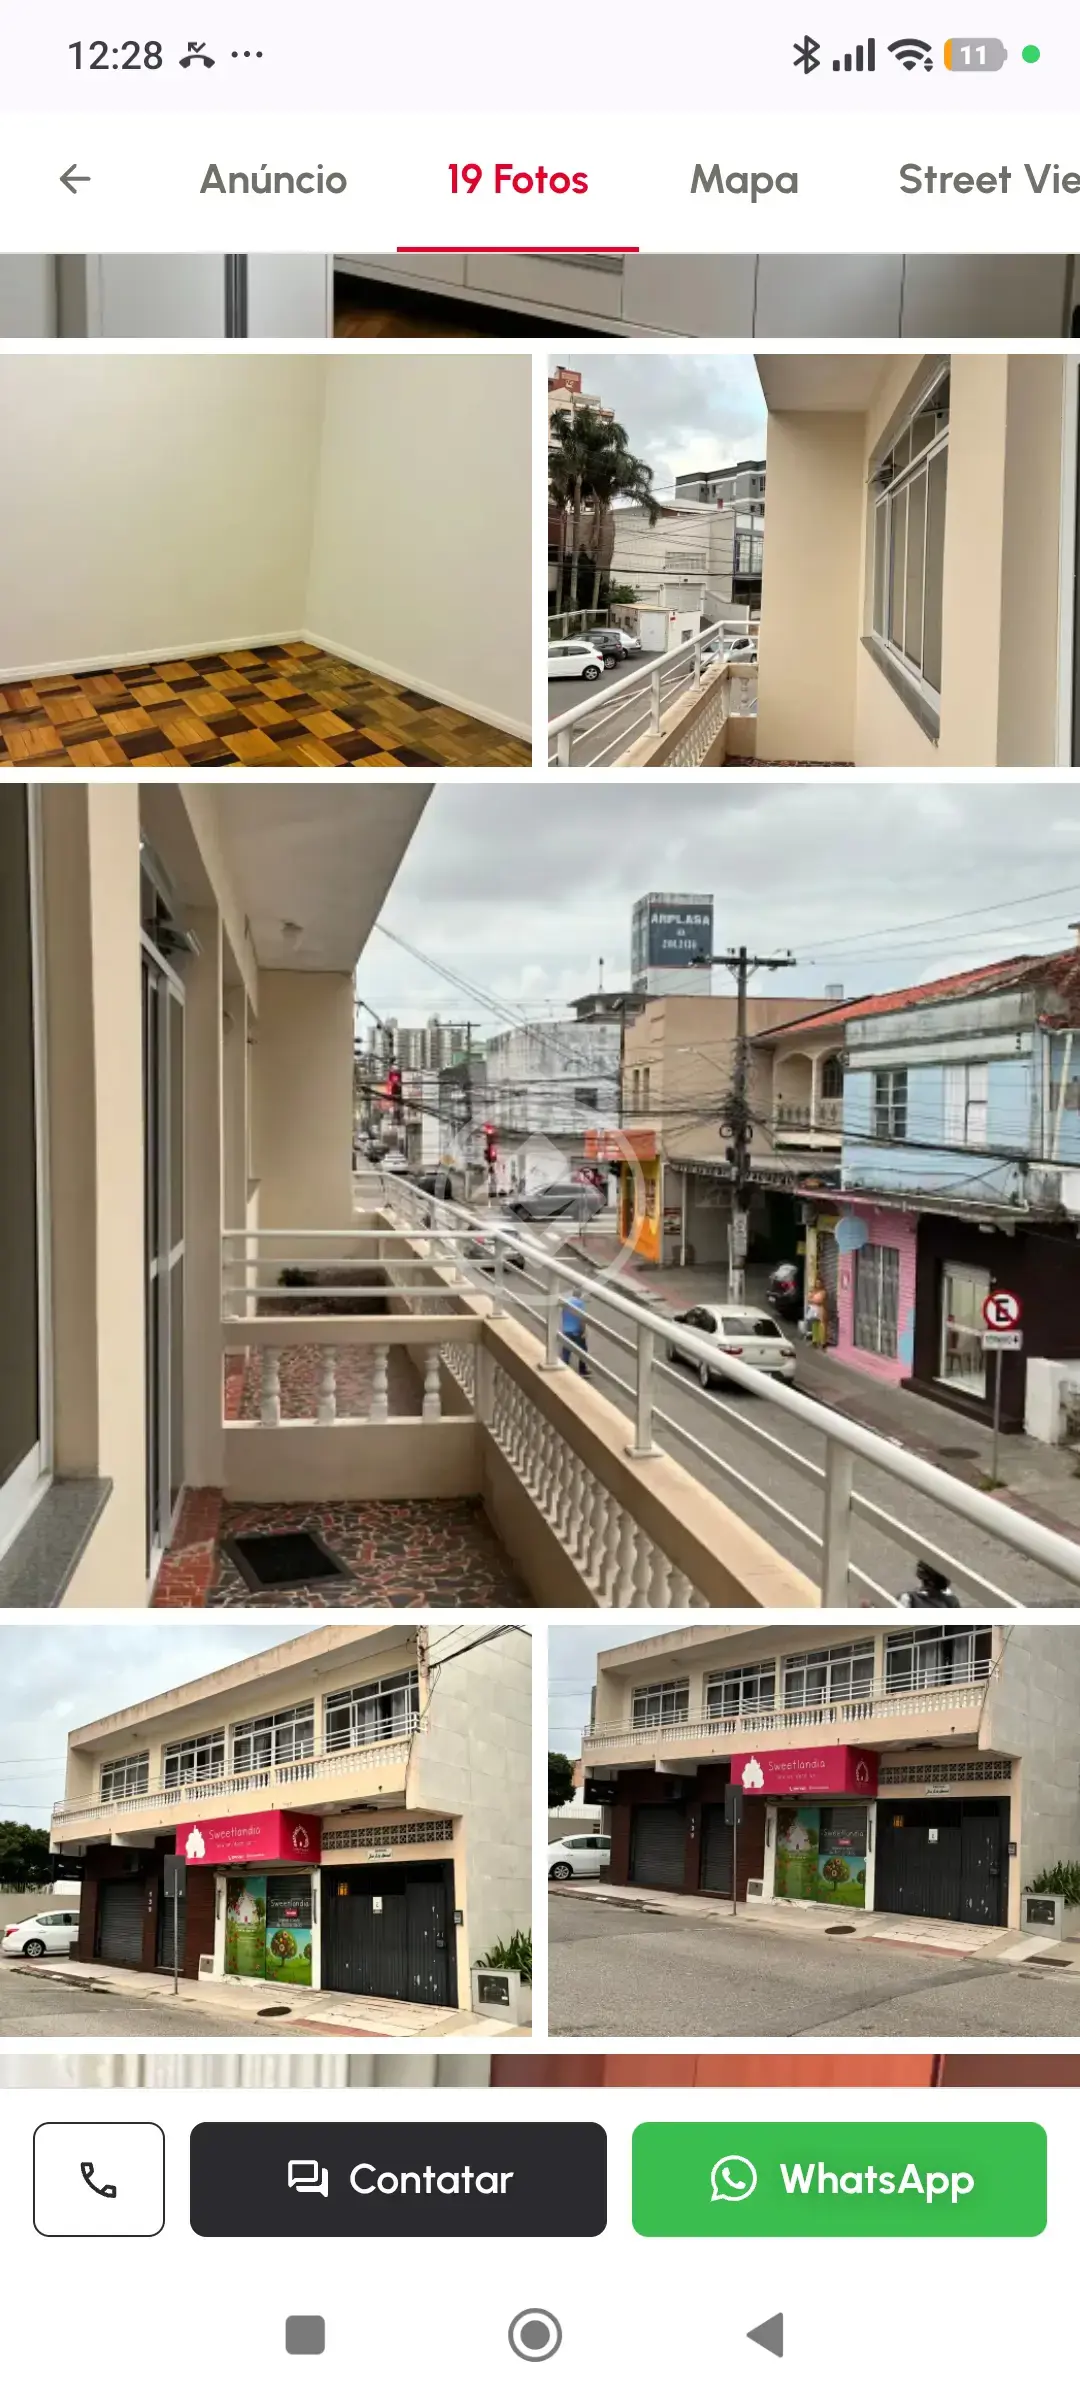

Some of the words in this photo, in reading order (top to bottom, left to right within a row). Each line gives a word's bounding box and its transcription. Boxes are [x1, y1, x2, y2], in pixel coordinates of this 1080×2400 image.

[68, 41, 163, 71] 12:28
[960, 45, 987, 65] 11
[200, 162, 348, 195] Anúncio
[447, 162, 483, 195] 19
[494, 162, 589, 195] Fotos
[689, 163, 799, 204] Mapa
[899, 162, 1012, 195] Street
[1024, 163, 1080, 195] Vie
[767, 1759, 826, 1771] Sweetlandia
[208, 1826, 261, 1840] Sweetlandia
[349, 2162, 515, 2195] Contatar
[779, 2161, 975, 2204] WhatsApp
